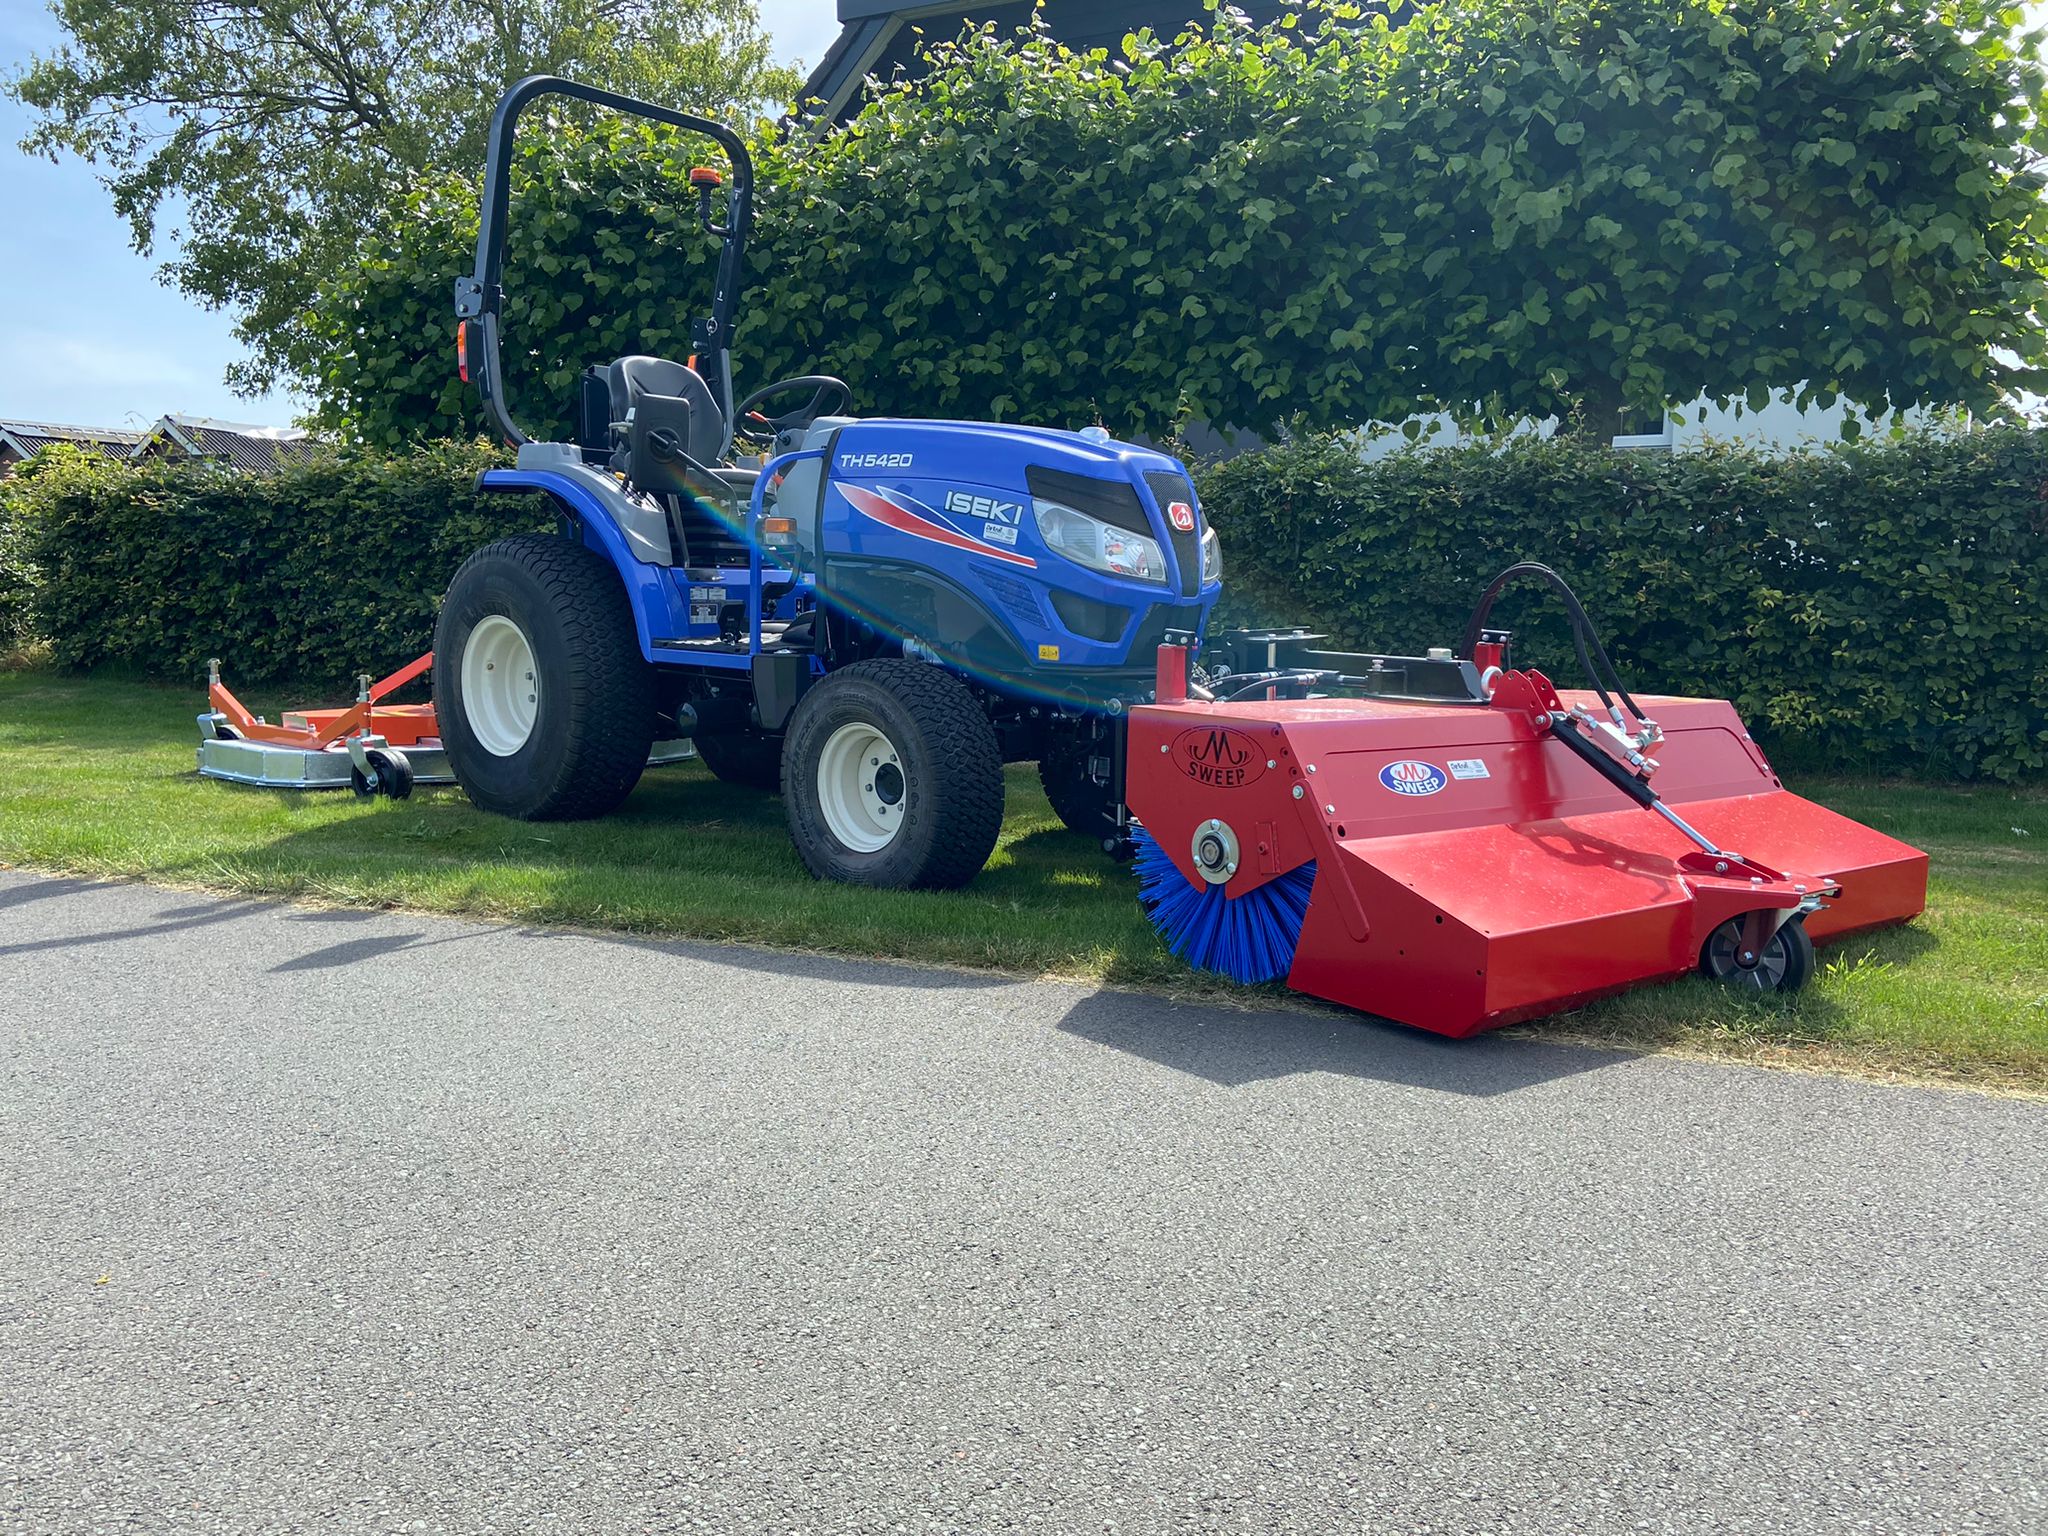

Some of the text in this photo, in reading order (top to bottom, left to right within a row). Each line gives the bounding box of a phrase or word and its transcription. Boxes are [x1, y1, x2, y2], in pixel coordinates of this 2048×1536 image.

[944, 490, 1024, 525] ISEKI
[1187, 761, 1245, 786] SWEEP
[1392, 777, 1439, 794] SWEEP
